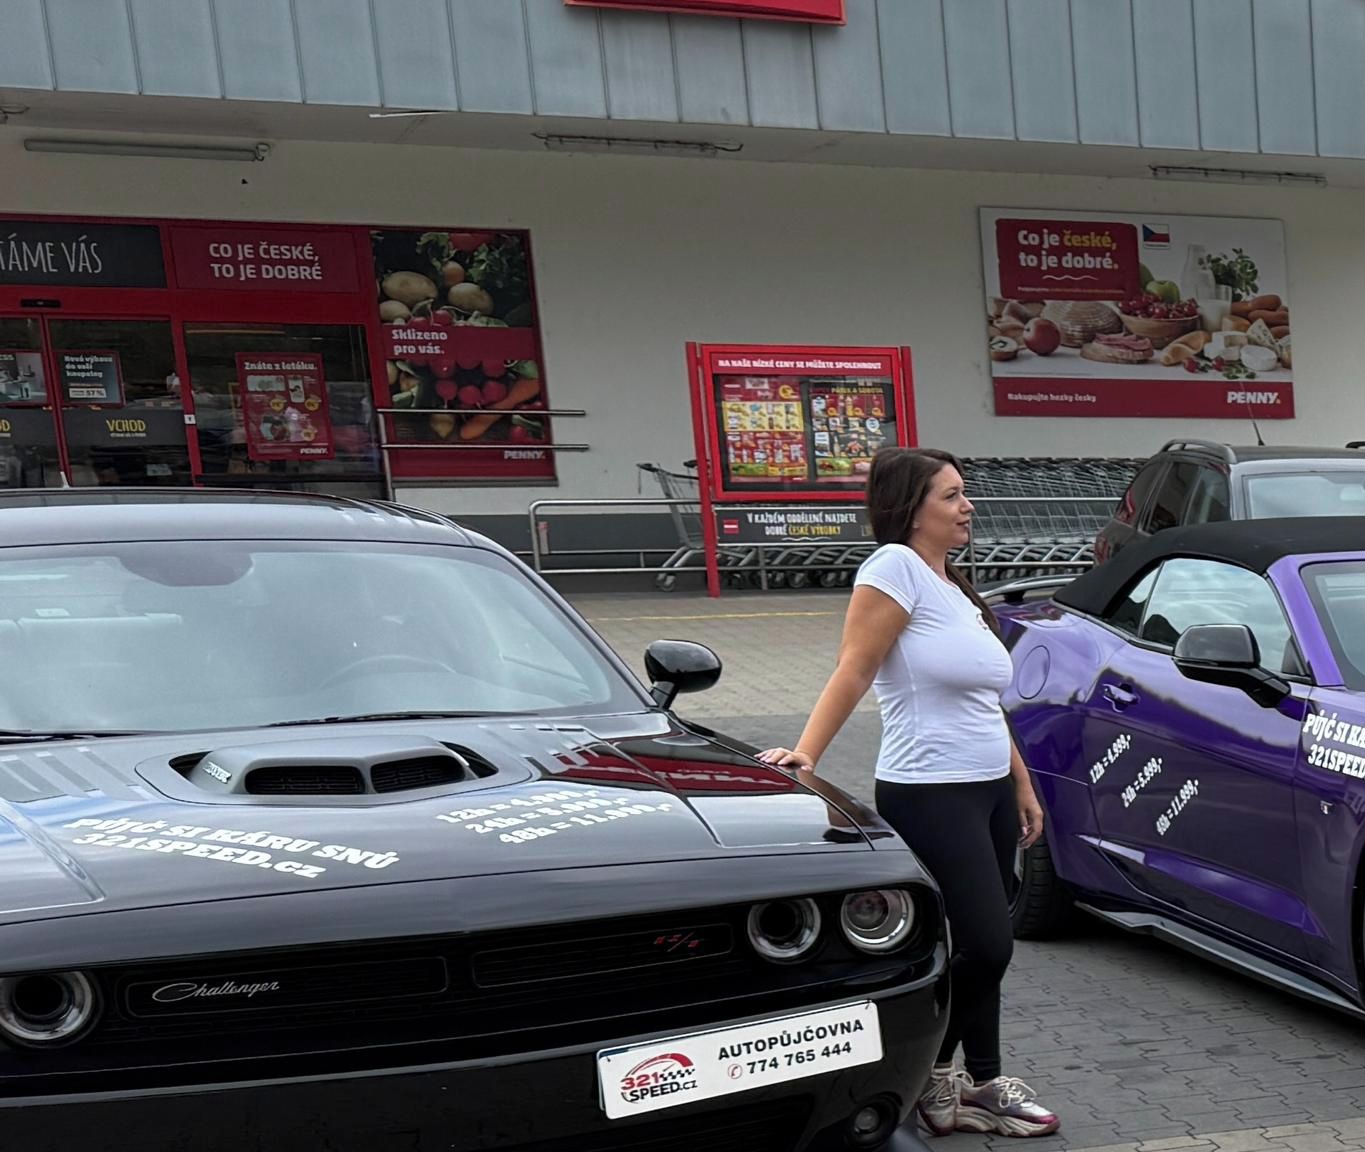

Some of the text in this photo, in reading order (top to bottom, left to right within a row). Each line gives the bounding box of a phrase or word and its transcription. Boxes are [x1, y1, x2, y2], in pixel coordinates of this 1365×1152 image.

[1017, 229, 1117, 249] Co je české,
[61, 234, 102, 273] VÁS
[209, 241, 319, 261] CO JE ČESKÉ,
[1018, 251, 1118, 270] to je dobré.
[210, 263, 322, 280] TO JE DOBRÉ
[391, 329, 448, 340] Sklizeno
[393, 343, 445, 355] pro vás.
[106, 419, 146, 432] VCHOD
[1333, 721, 1350, 743] SI
[72, 833, 327, 879] 321SPEED.cz
[160, 824, 202, 838] SI
[202, 829, 321, 852] KÁRU
[312, 843, 400, 869] SNŮ
[152, 981, 280, 1003] Challenger
[718, 1019, 864, 1061] AUTOPŮJČOVNA
[747, 1041, 852, 1075] 774 765 444
[620, 1072, 660, 1090] 321
[629, 1079, 697, 1103] SPEED.cz
